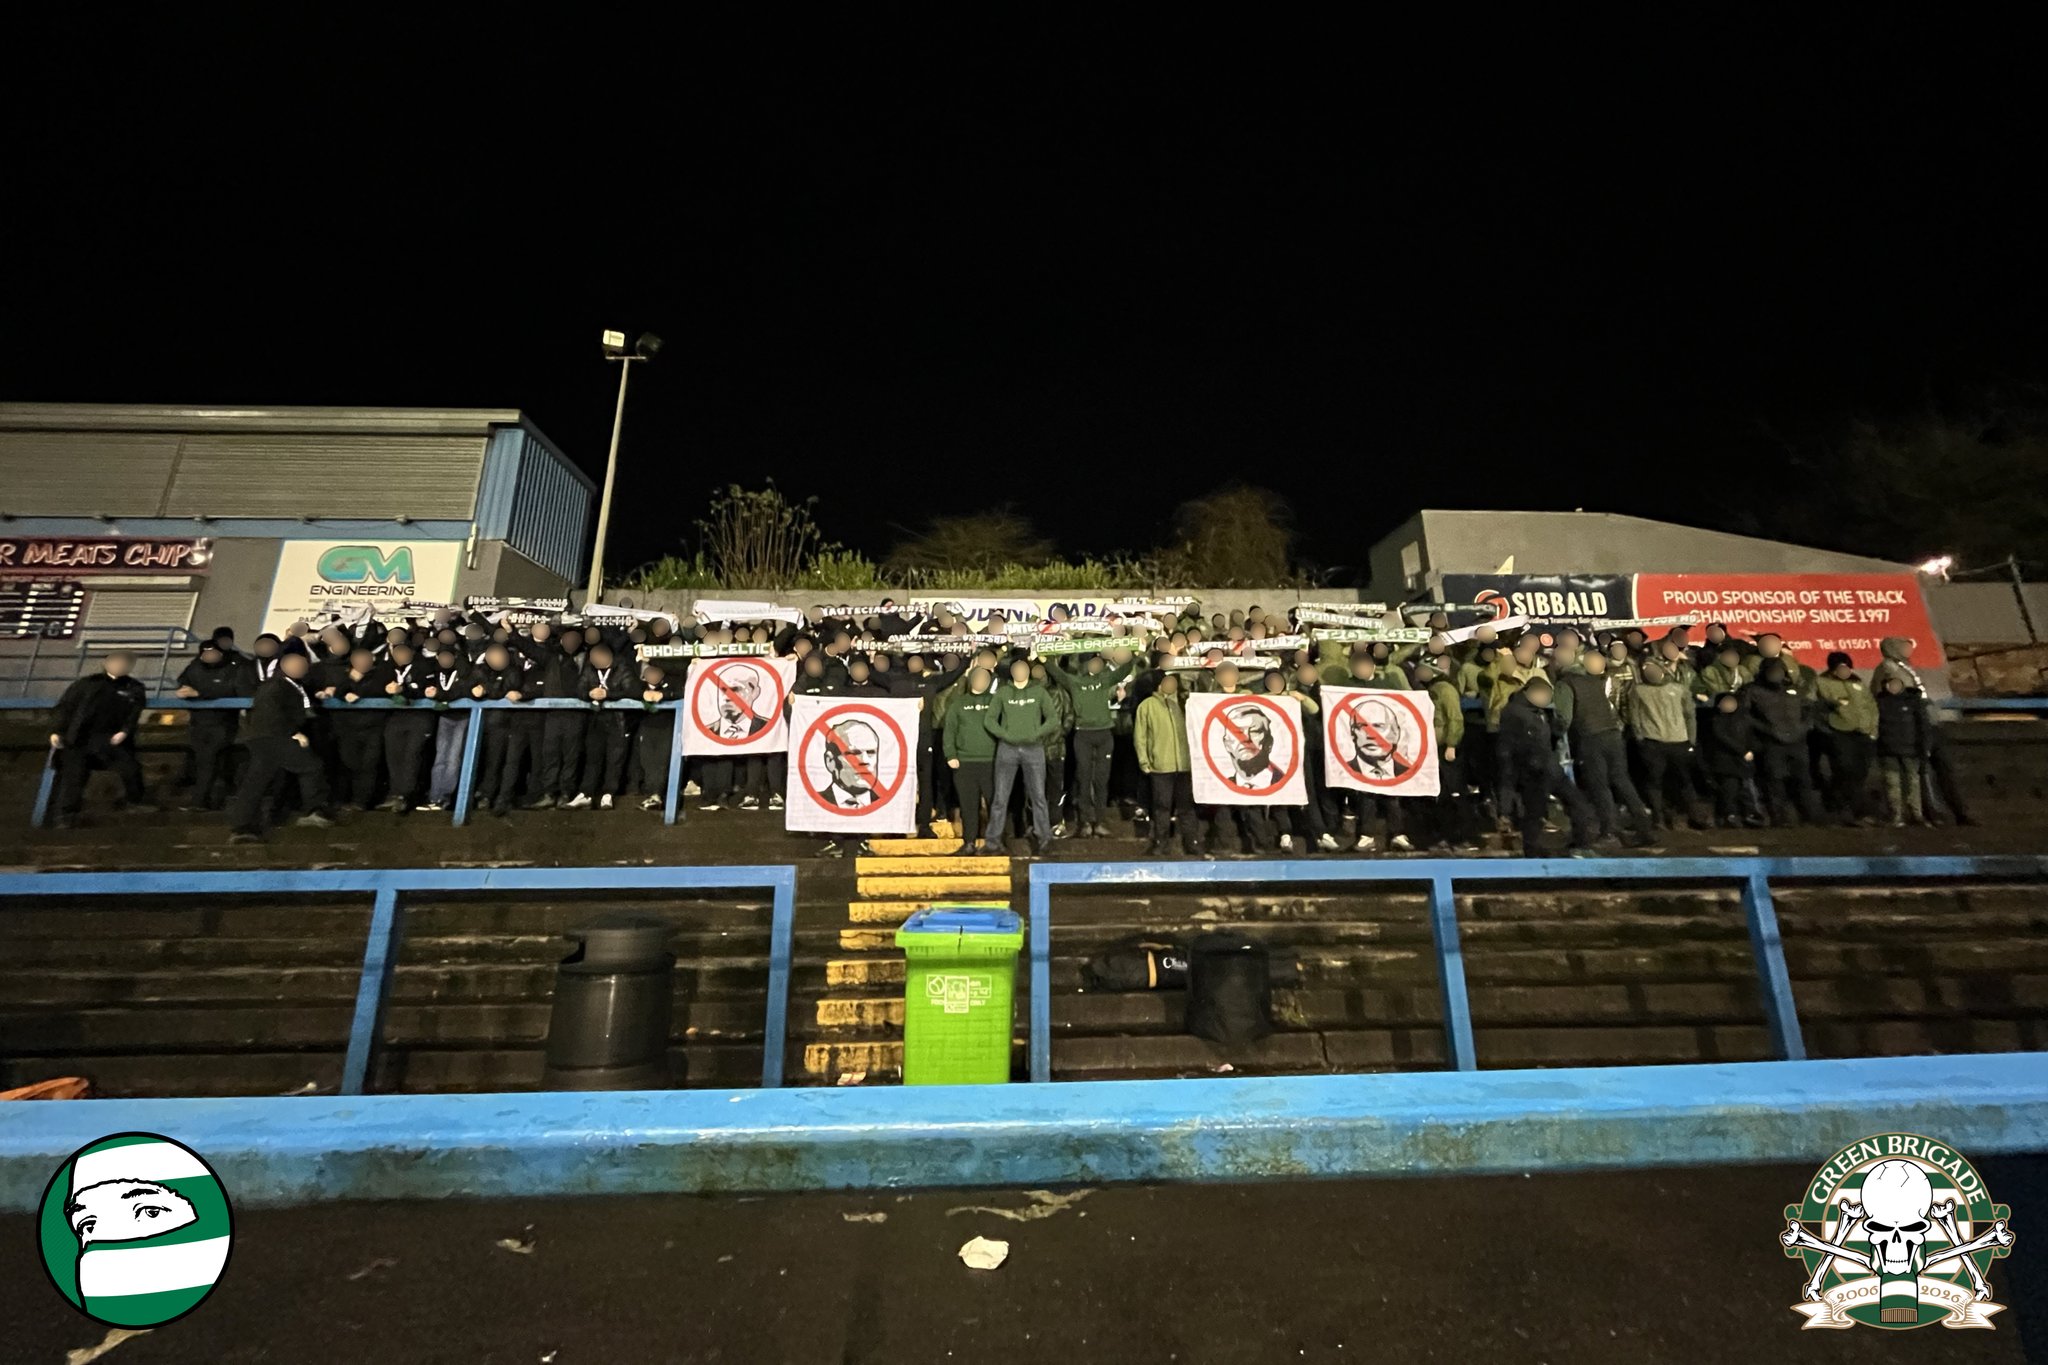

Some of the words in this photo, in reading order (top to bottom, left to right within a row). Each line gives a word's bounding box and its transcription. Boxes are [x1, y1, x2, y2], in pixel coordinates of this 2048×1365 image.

[22, 544, 118, 566] MEATS
[123, 543, 205, 567] CHIPS
[309, 585, 415, 596] ENGINEERING
[1663, 590, 1718, 605] PROUD
[1722, 590, 1797, 605] SPONSOR
[1800, 590, 1820, 605] OF
[1823, 590, 1855, 605] THE
[1856, 590, 1907, 605] TRACK
[1511, 591, 1608, 616] SIBBALD
[1688, 608, 1806, 624] CHAMPIONSHIP
[1809, 609, 1856, 623] SINCE
[1858, 609, 1890, 623] 1997
[719, 643, 769, 655] CELTIC
[1036, 640, 1081, 653] GREEN
[1083, 637, 1139, 650] BRIGADE
[1839, 638, 1872, 650] 01501
